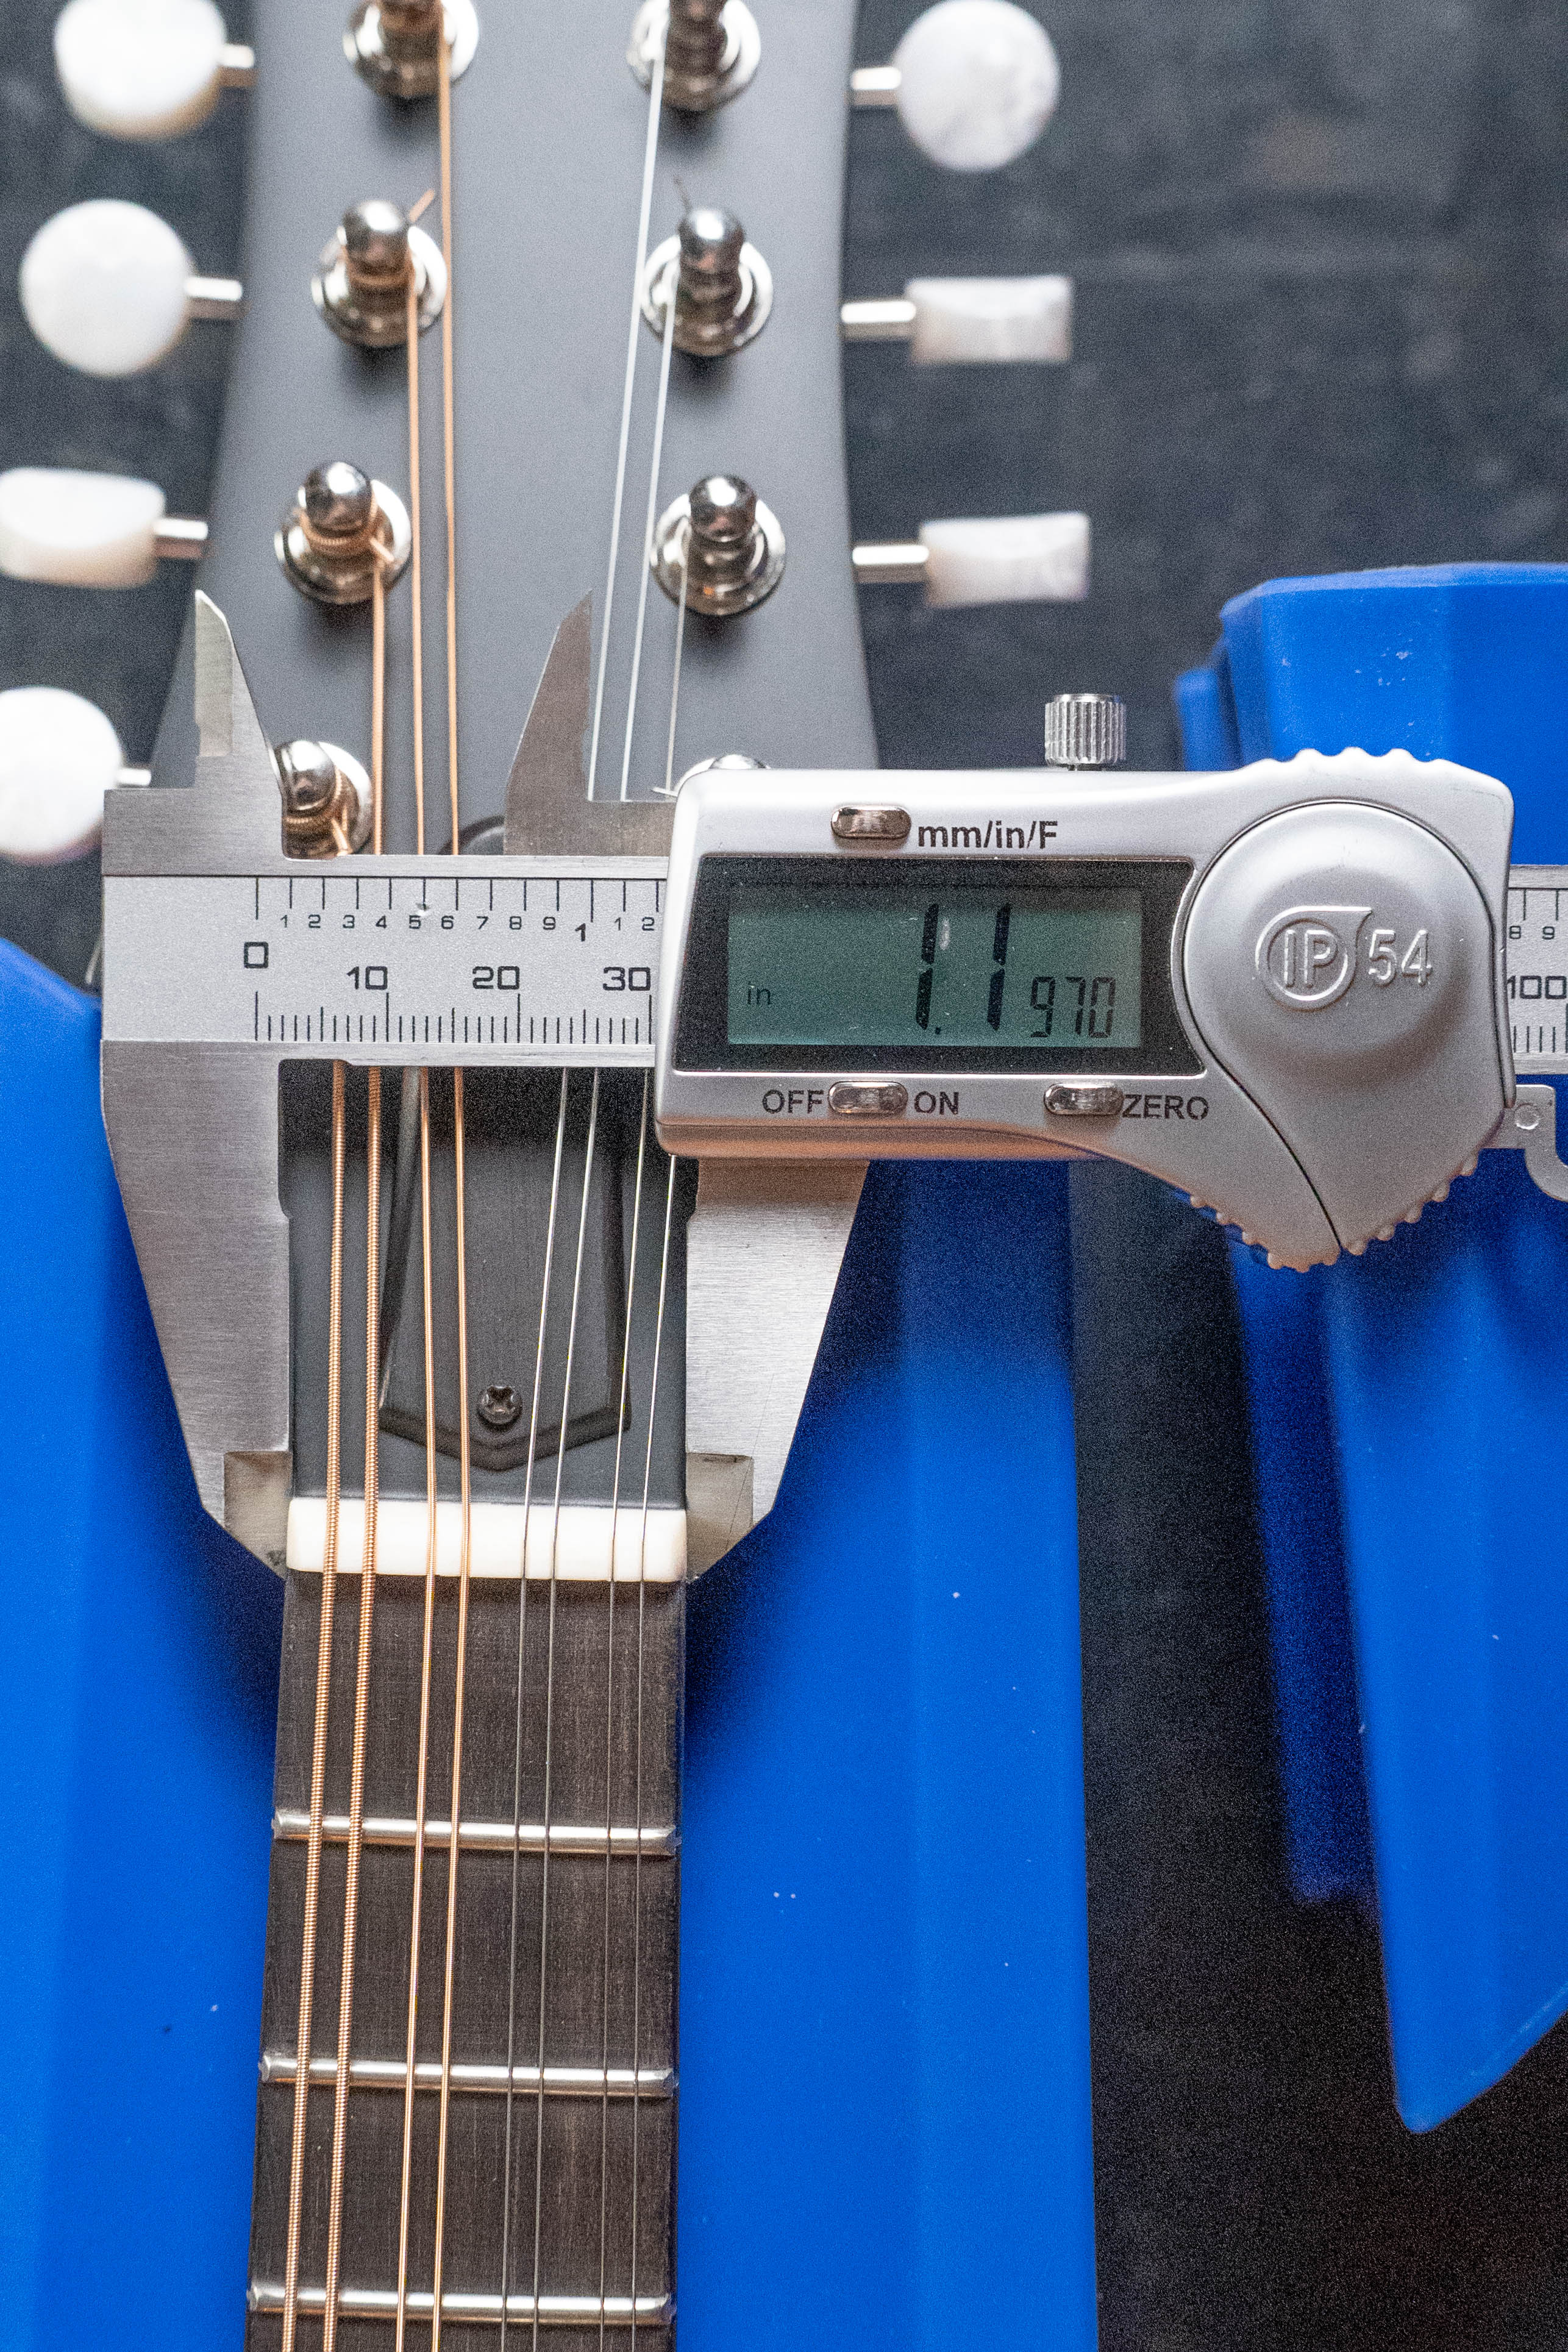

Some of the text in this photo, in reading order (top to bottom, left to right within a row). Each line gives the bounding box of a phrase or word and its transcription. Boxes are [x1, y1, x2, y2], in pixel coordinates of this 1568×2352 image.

[918, 820, 1059, 850] mm/in/F
[280, 914, 656, 943] 1 2 3 4 5 6 7 8 9 1 1 2
[1508, 925, 1556, 941] 8 9
[242, 941, 270, 969] 0
[1282, 928, 1433, 989] IP 54
[346, 965, 652, 992] 10 20 30
[1506, 974, 1568, 1000] 100
[747, 981, 772, 1006] in
[761, 1088, 960, 1116] OFF ON
[1121, 1093, 1210, 1121] ZERO
